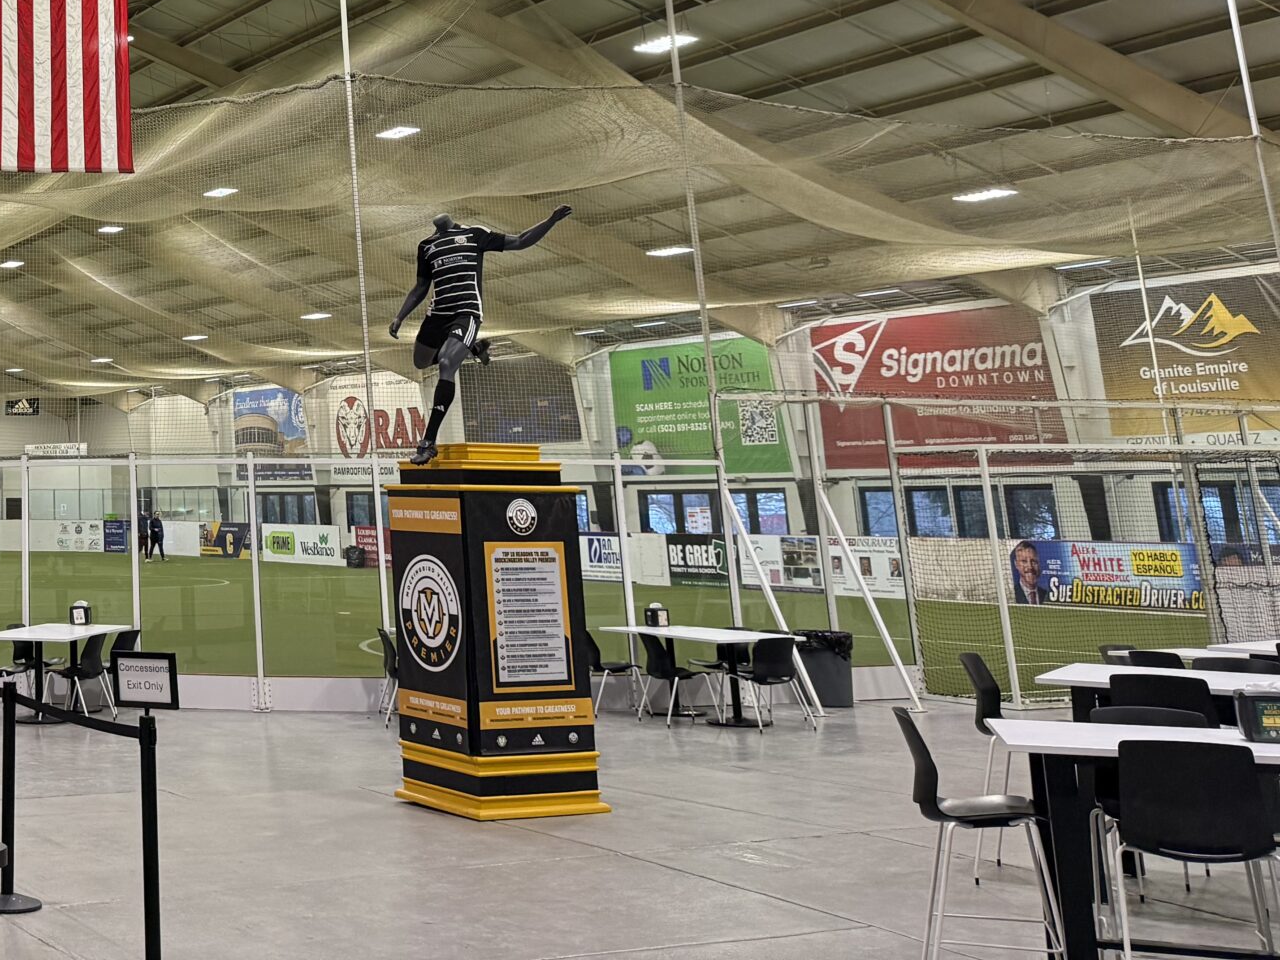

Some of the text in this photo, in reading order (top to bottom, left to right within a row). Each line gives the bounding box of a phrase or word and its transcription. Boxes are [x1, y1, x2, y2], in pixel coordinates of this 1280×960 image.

[880, 341, 1042, 383] Signarama
[1139, 360, 1249, 379] Granite Empire
[679, 371, 760, 389] SPORT HEALTH
[937, 370, 1045, 388] DOWNTOWN
[1153, 378, 1240, 395] of Louisville
[635, 403, 654, 412] SCAN
[655, 401, 673, 411] HERE
[637, 410, 710, 425] appointment online tod
[646, 424, 657, 433] call
[657, 424, 676, 433] (502)
[709, 420, 735, 430] (AM)
[272, 535, 290, 551] PRIME
[300, 541, 335, 557] WesBanco
[857, 538, 894, 548] INSURANCE
[1071, 544, 1089, 556] ALEX
[669, 544, 685, 566] BE
[1132, 551, 1177, 562] YO HABLO
[1080, 556, 1125, 572] WHITE
[1136, 562, 1178, 575] ESPAÑOL
[405, 625, 458, 663] PREMIER
[119, 662, 170, 673] Concessions
[127, 680, 164, 693] Exit Only
[496, 707, 511, 715] YOUR
[512, 706, 536, 714] PATHWAY
[544, 704, 576, 713] GREATNESS!
